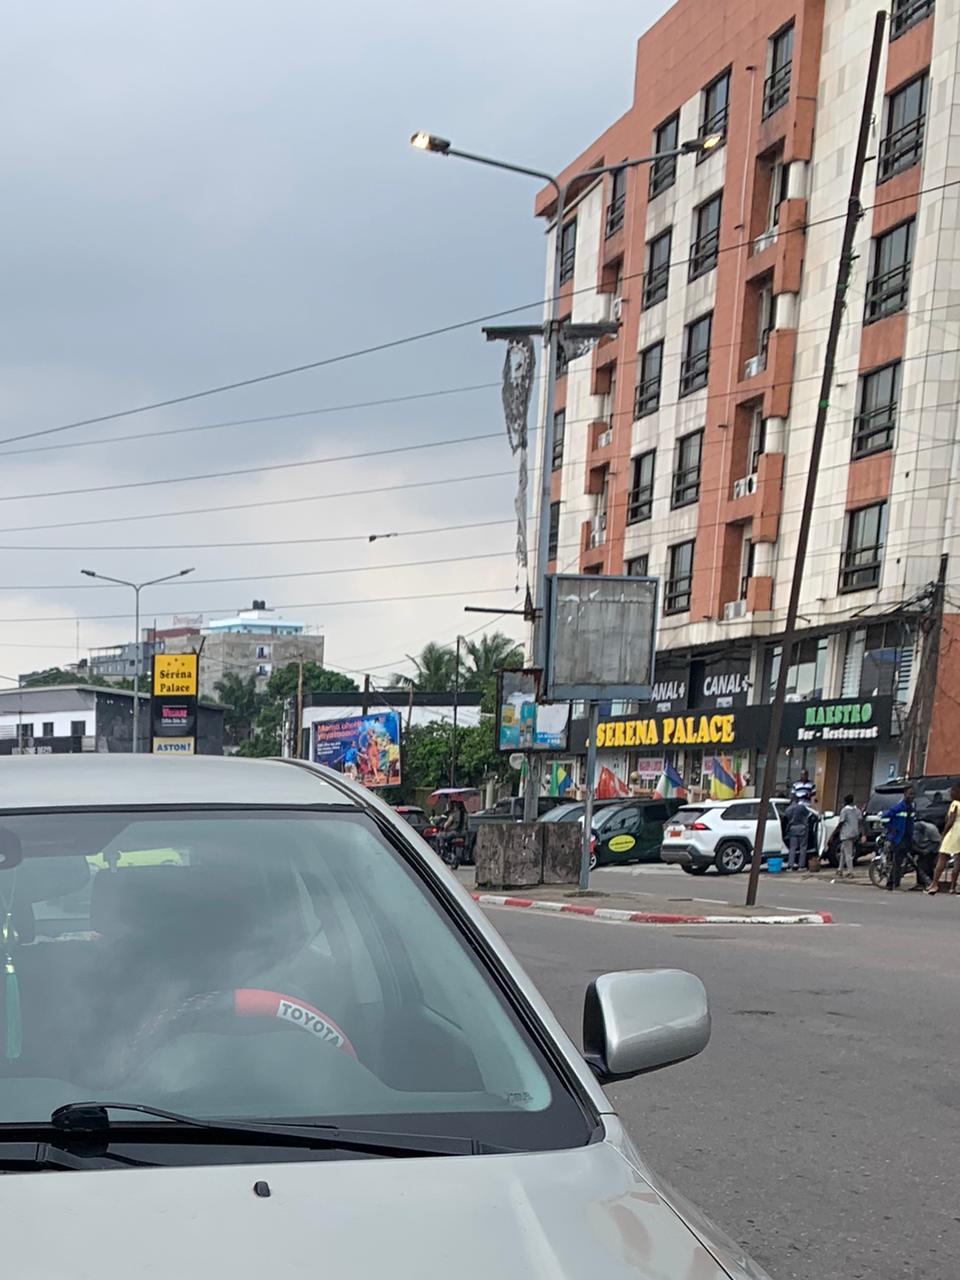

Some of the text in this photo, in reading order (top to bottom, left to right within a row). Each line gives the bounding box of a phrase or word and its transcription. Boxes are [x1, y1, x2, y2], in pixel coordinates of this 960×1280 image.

[160, 683, 191, 693] Palace
[652, 681, 686, 701] ANAL+
[596, 718, 659, 748] SERENA
[662, 714, 735, 745] PALACE
[282, 1003, 341, 1047] TOYOTA
